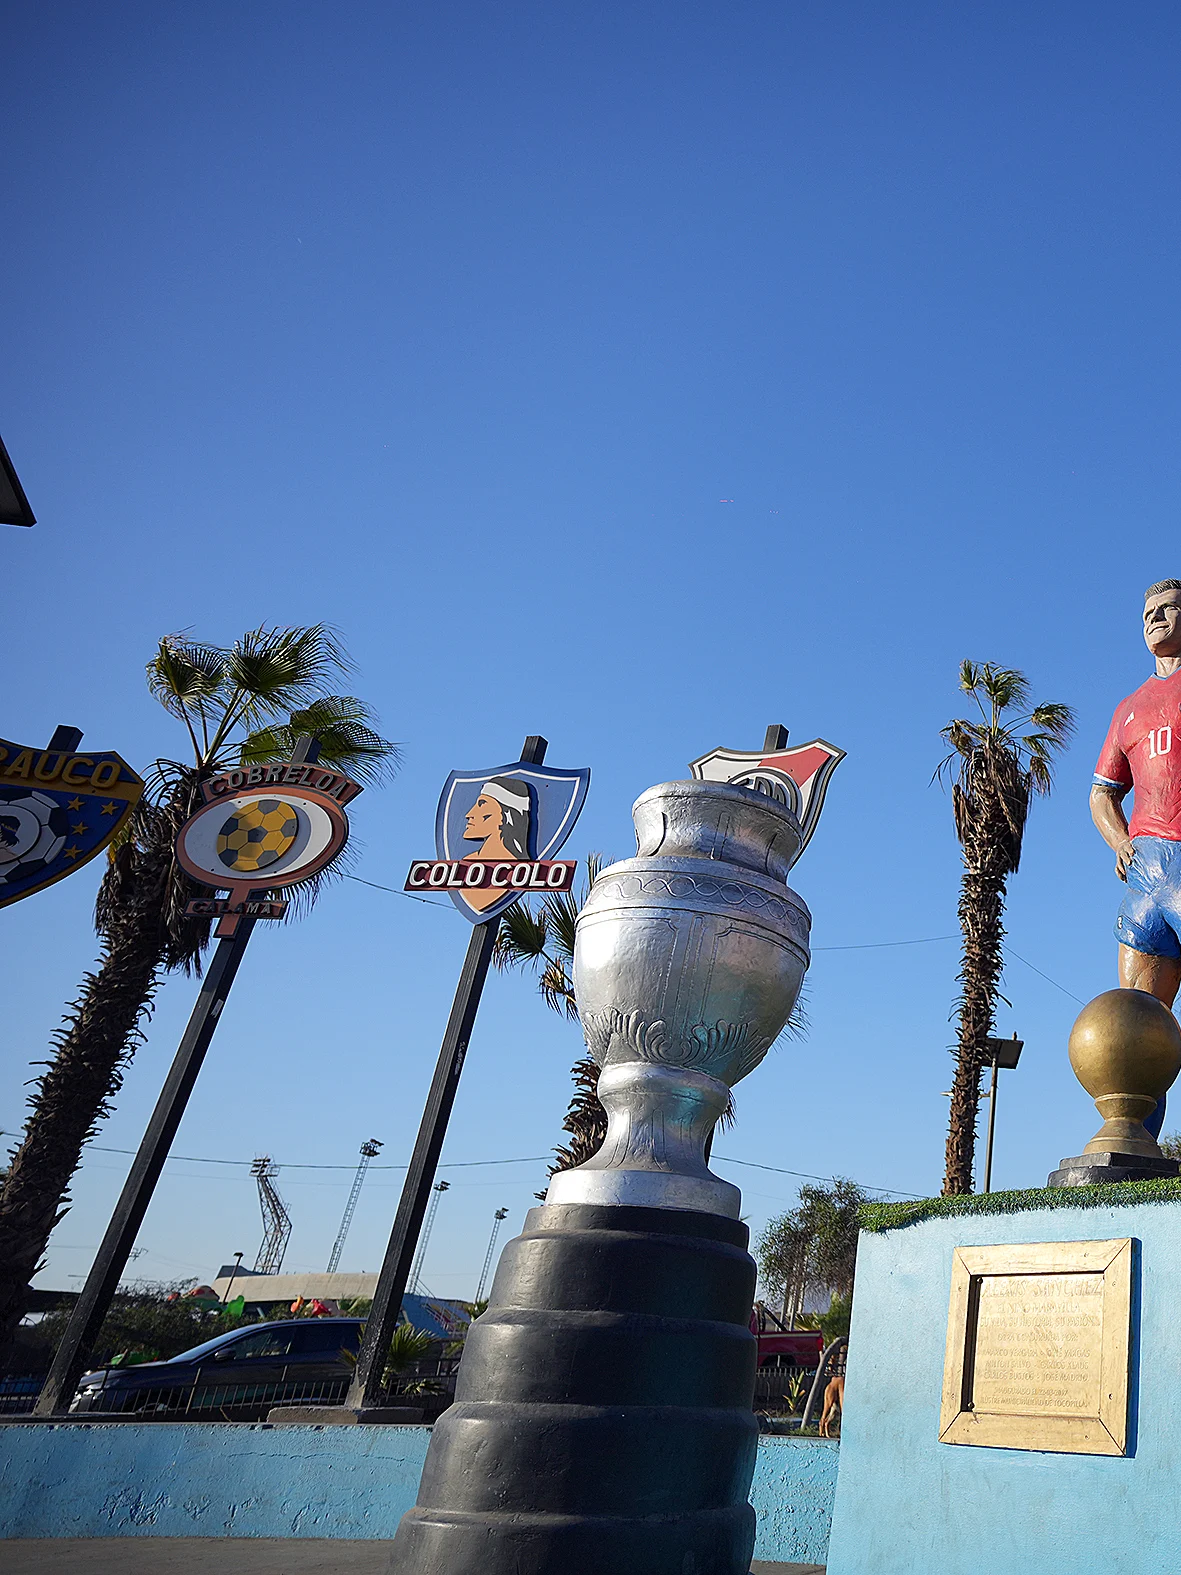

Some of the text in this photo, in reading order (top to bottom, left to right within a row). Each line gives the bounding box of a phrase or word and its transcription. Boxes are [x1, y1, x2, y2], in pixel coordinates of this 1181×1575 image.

[1148, 726, 1171, 759] 10
[209, 765, 350, 800] COBRELOA
[409, 862, 567, 887] COLO COLO
[192, 902, 272, 914] CALAMA
